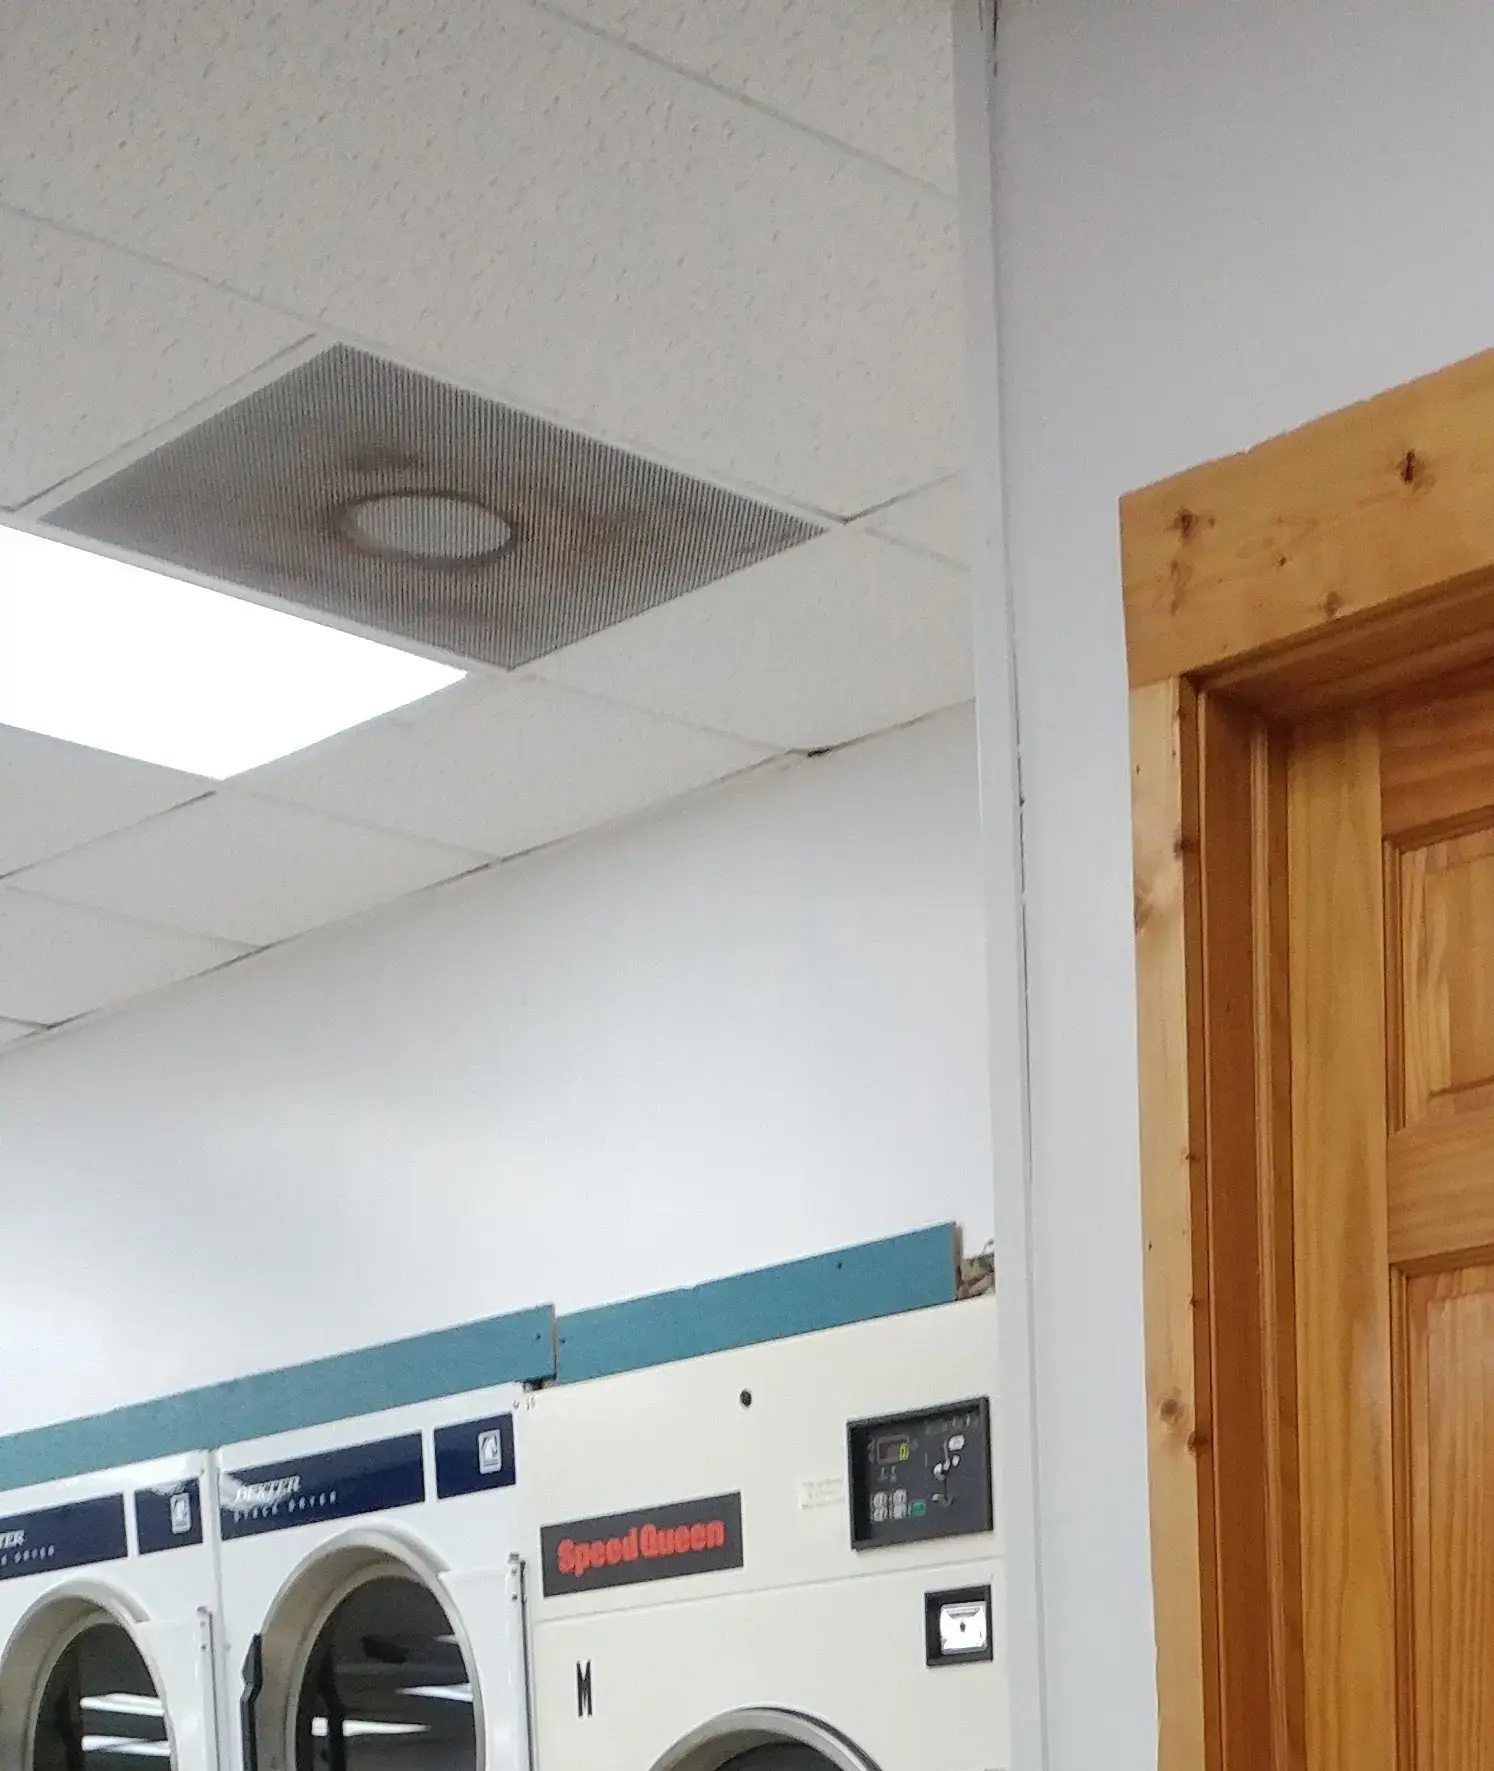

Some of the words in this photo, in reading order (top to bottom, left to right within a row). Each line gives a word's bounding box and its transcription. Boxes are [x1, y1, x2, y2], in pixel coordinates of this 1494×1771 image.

[233, 1475, 301, 1505] DEXTER
[557, 1538, 638, 1577] Speed
[640, 1521, 724, 1557] Queen
[576, 1660, 592, 1717] M
